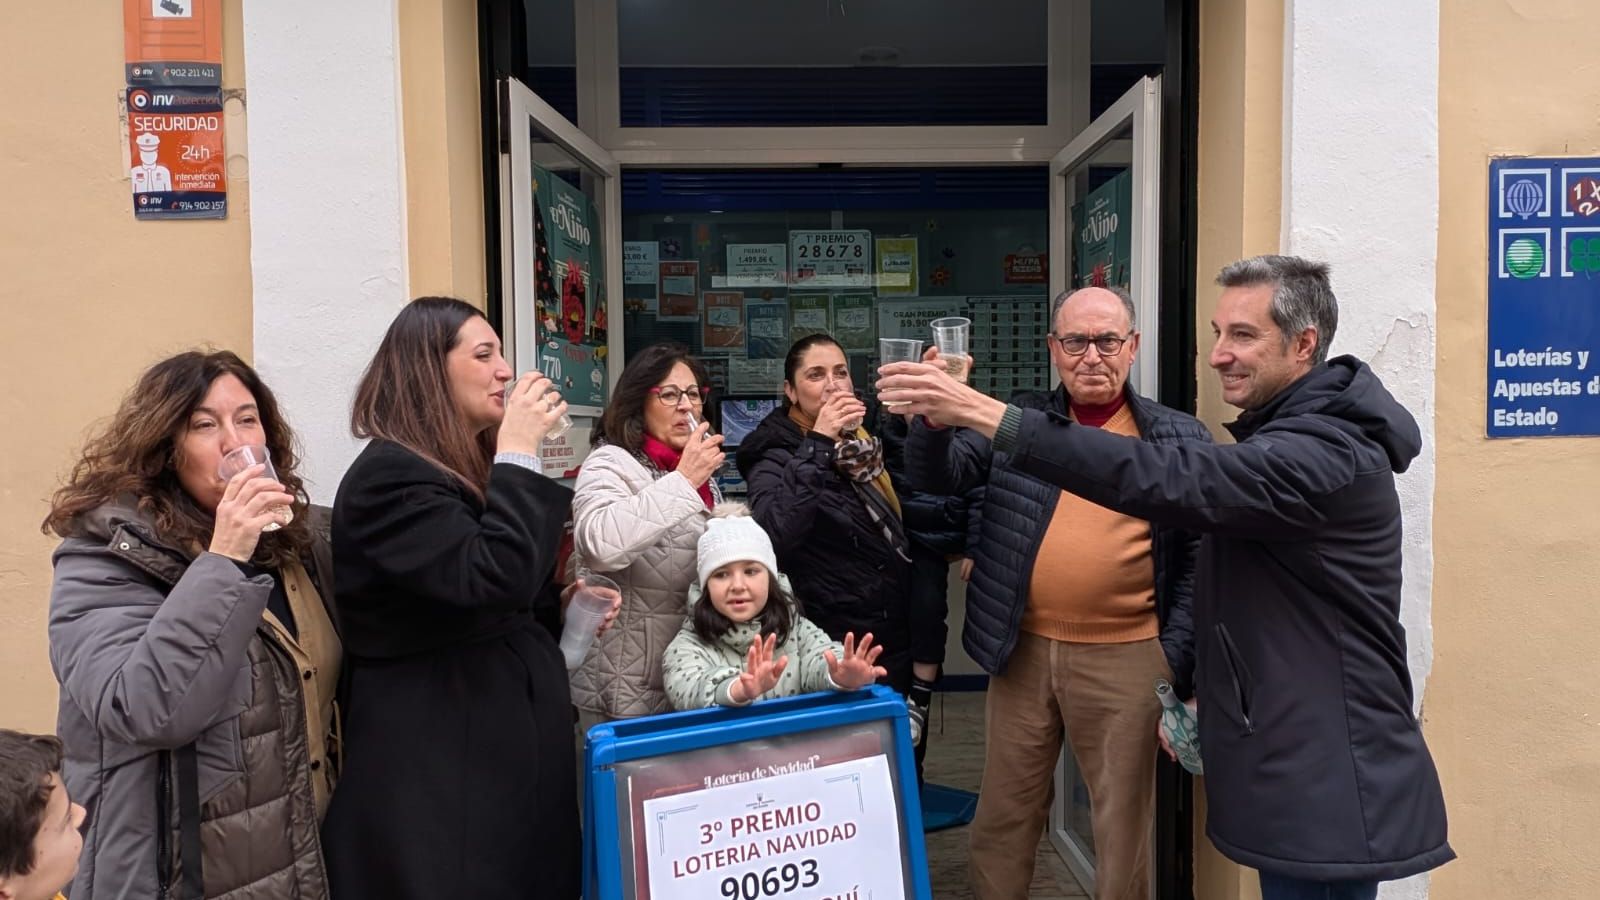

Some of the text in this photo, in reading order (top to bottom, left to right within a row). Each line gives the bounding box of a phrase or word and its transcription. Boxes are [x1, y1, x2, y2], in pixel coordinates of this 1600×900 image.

[170, 68, 215, 78] 902 211 411
[134, 116, 218, 131] SEGURIDAD
[175, 172, 220, 182] intervención
[179, 181, 216, 189] inmediata
[179, 201, 225, 211] 914 902 157
[815, 234, 856, 244] PREMIO
[798, 244, 863, 258] 28678
[917, 310, 947, 318] PREMIO
[1494, 347, 1589, 370] Loterías y
[1493, 375, 1600, 401] Apuestas d
[1494, 406, 1558, 427] Estado
[751, 766, 767, 780] de
[768, 755, 820, 777] Navidad
[730, 801, 822, 839] PREMIO
[672, 821, 858, 879] LOTERIA NAVIDAD
[720, 858, 821, 900] 90693
